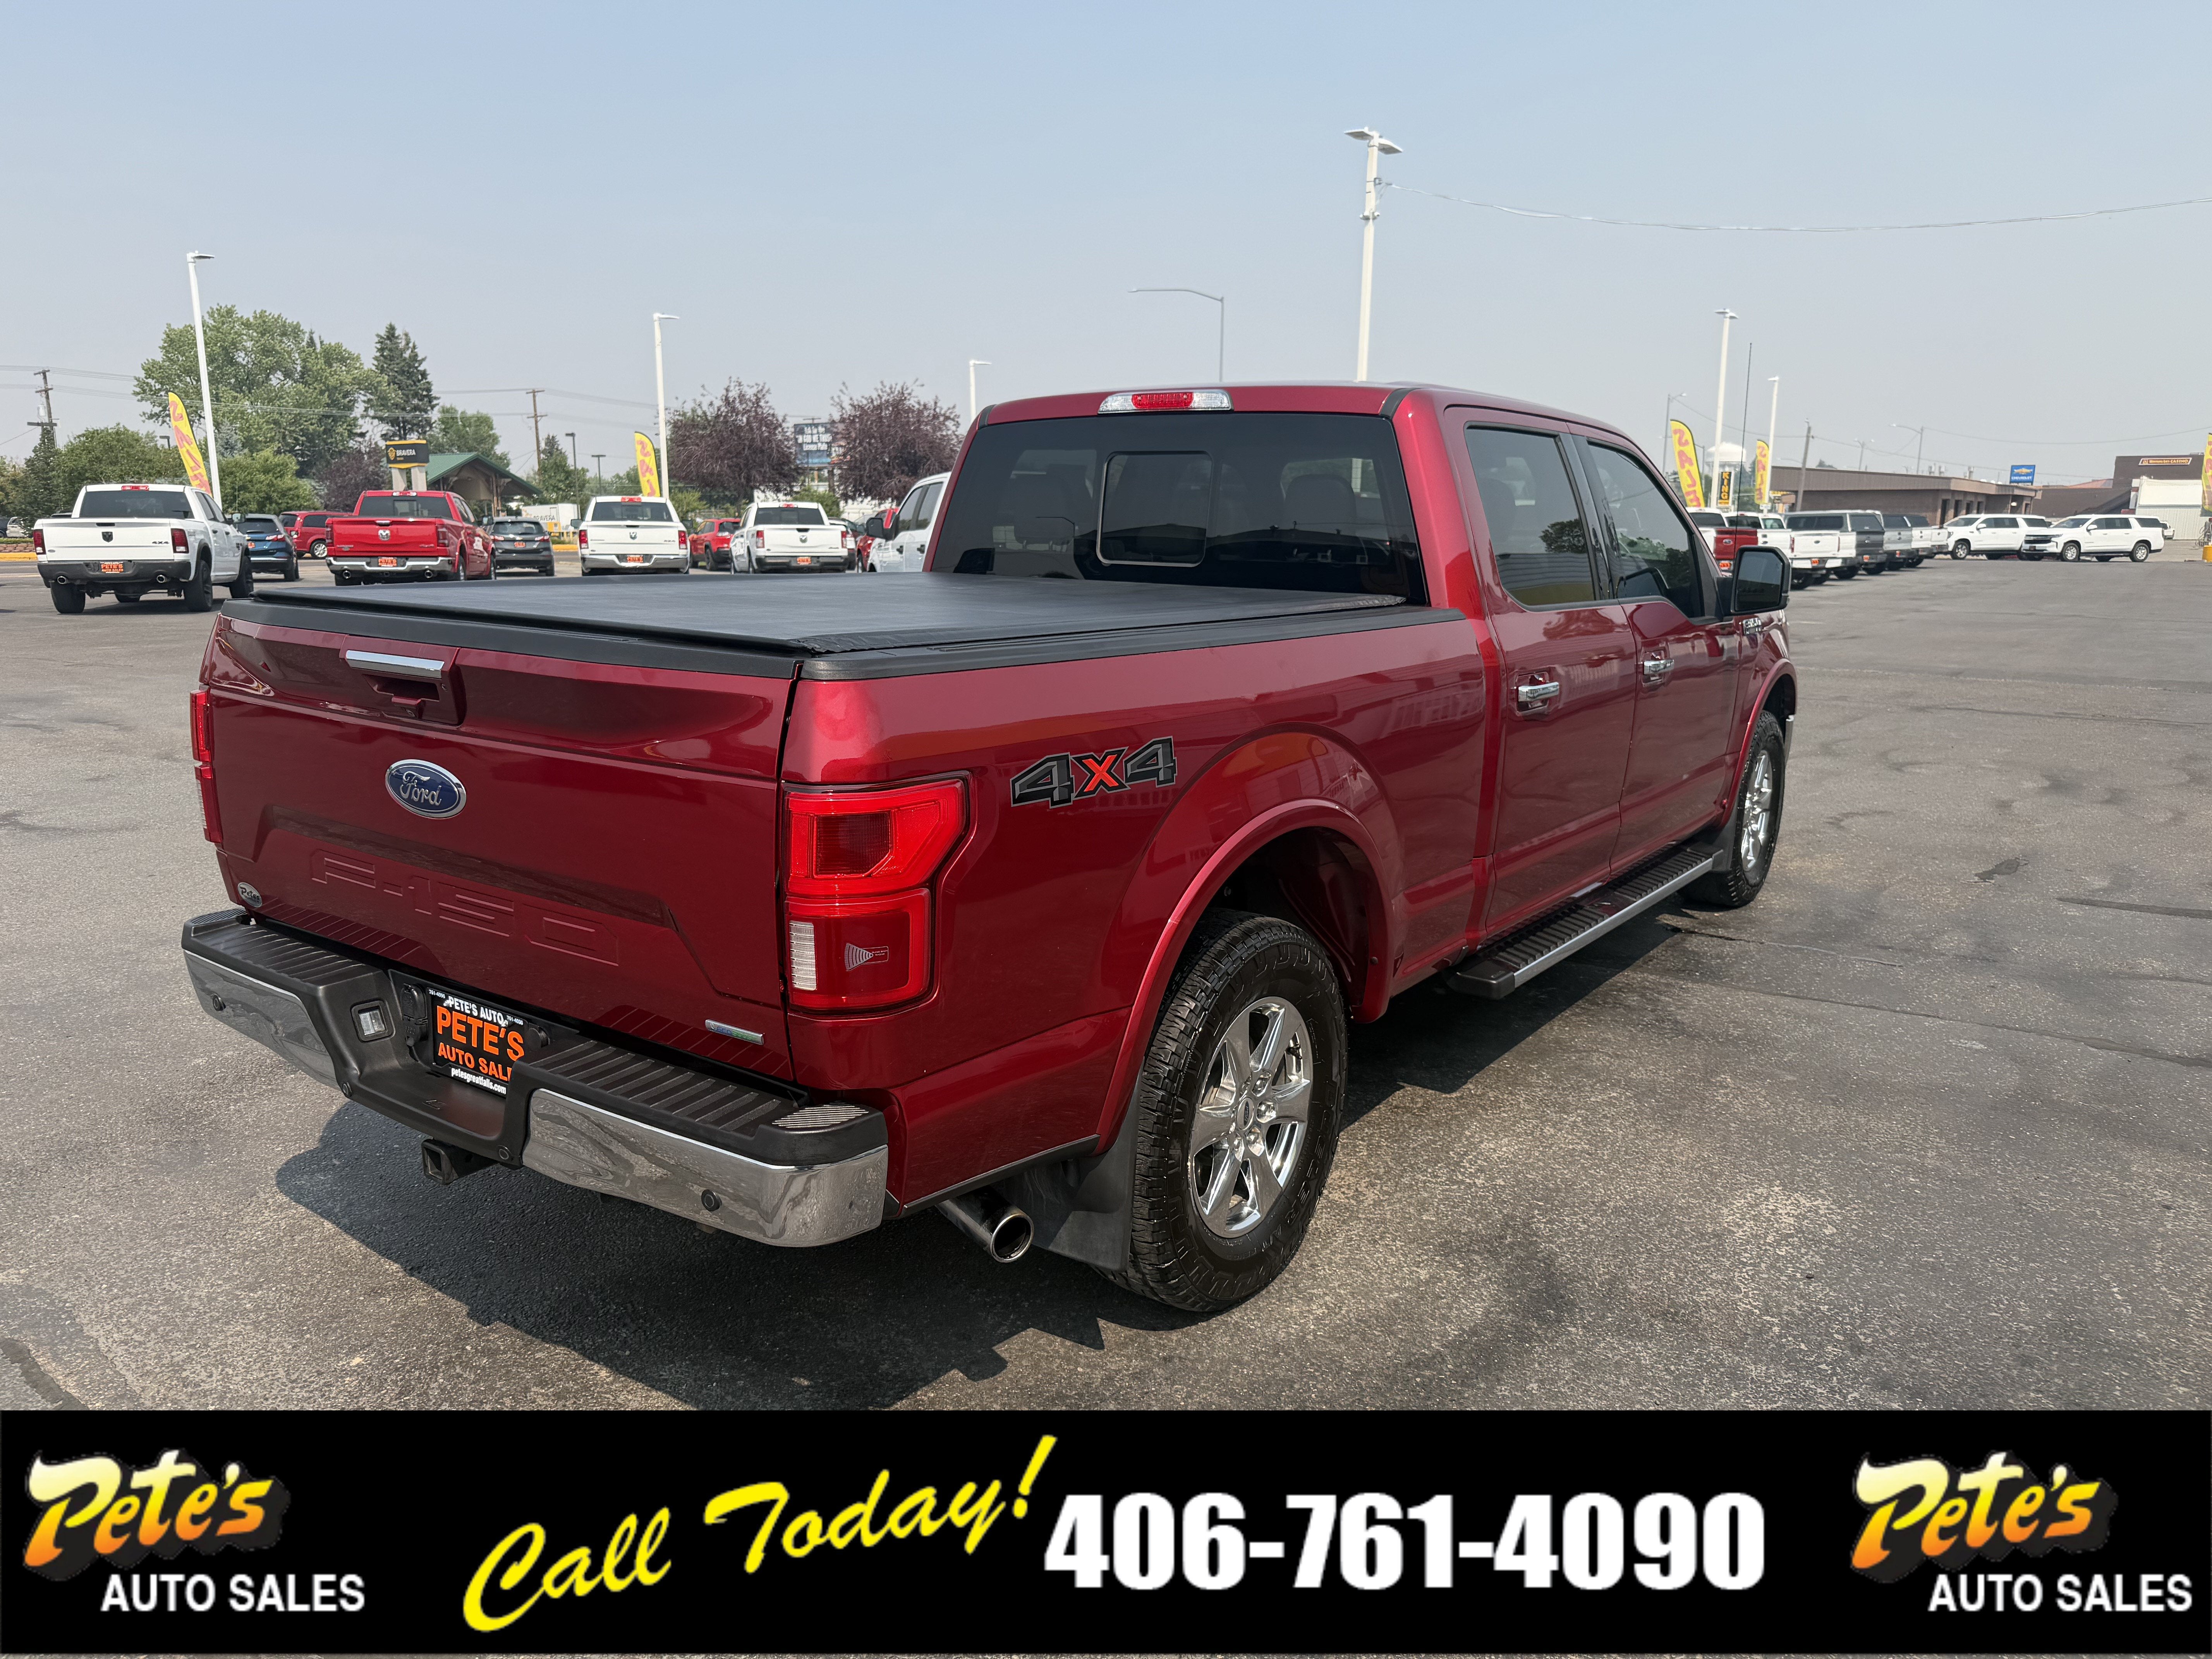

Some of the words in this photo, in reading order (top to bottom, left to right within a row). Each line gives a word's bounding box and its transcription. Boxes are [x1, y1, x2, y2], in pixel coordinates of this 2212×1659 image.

[1721, 472, 1729, 499] KING
[400, 771, 442, 806] Ford
[448, 996, 478, 1017] PETE'S
[480, 1006, 504, 1025] AUTO
[437, 1005, 525, 1061] PETE'S
[438, 1042, 475, 1068] AUTO
[479, 1058, 512, 1082] SAL
[451, 1068, 506, 1095] petesgreatfalls.com
